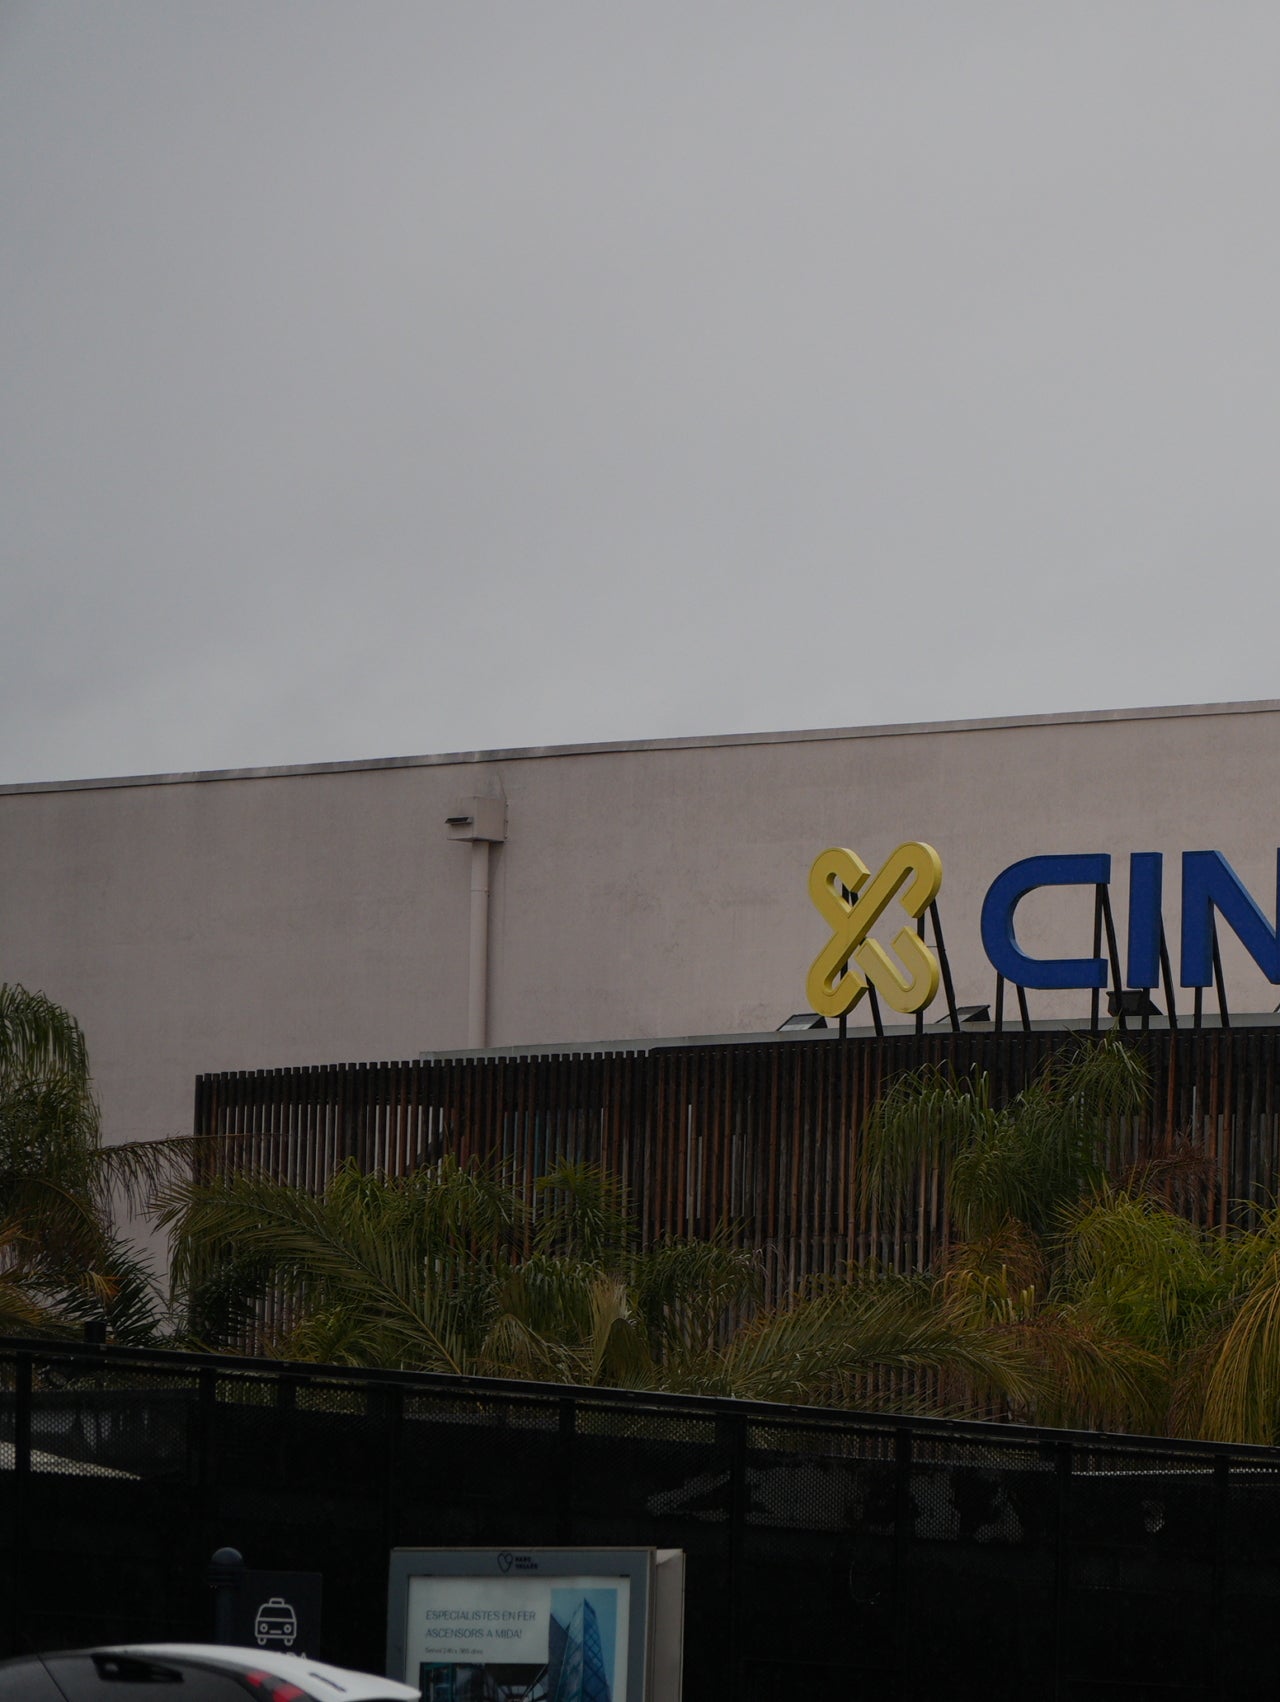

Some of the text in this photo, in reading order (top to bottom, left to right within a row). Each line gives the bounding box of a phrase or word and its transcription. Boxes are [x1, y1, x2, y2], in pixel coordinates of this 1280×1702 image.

[426, 1610, 536, 1621] ESPECIALISTES EN FER
[426, 1628, 522, 1639] ASCENSORS A MIDA!
